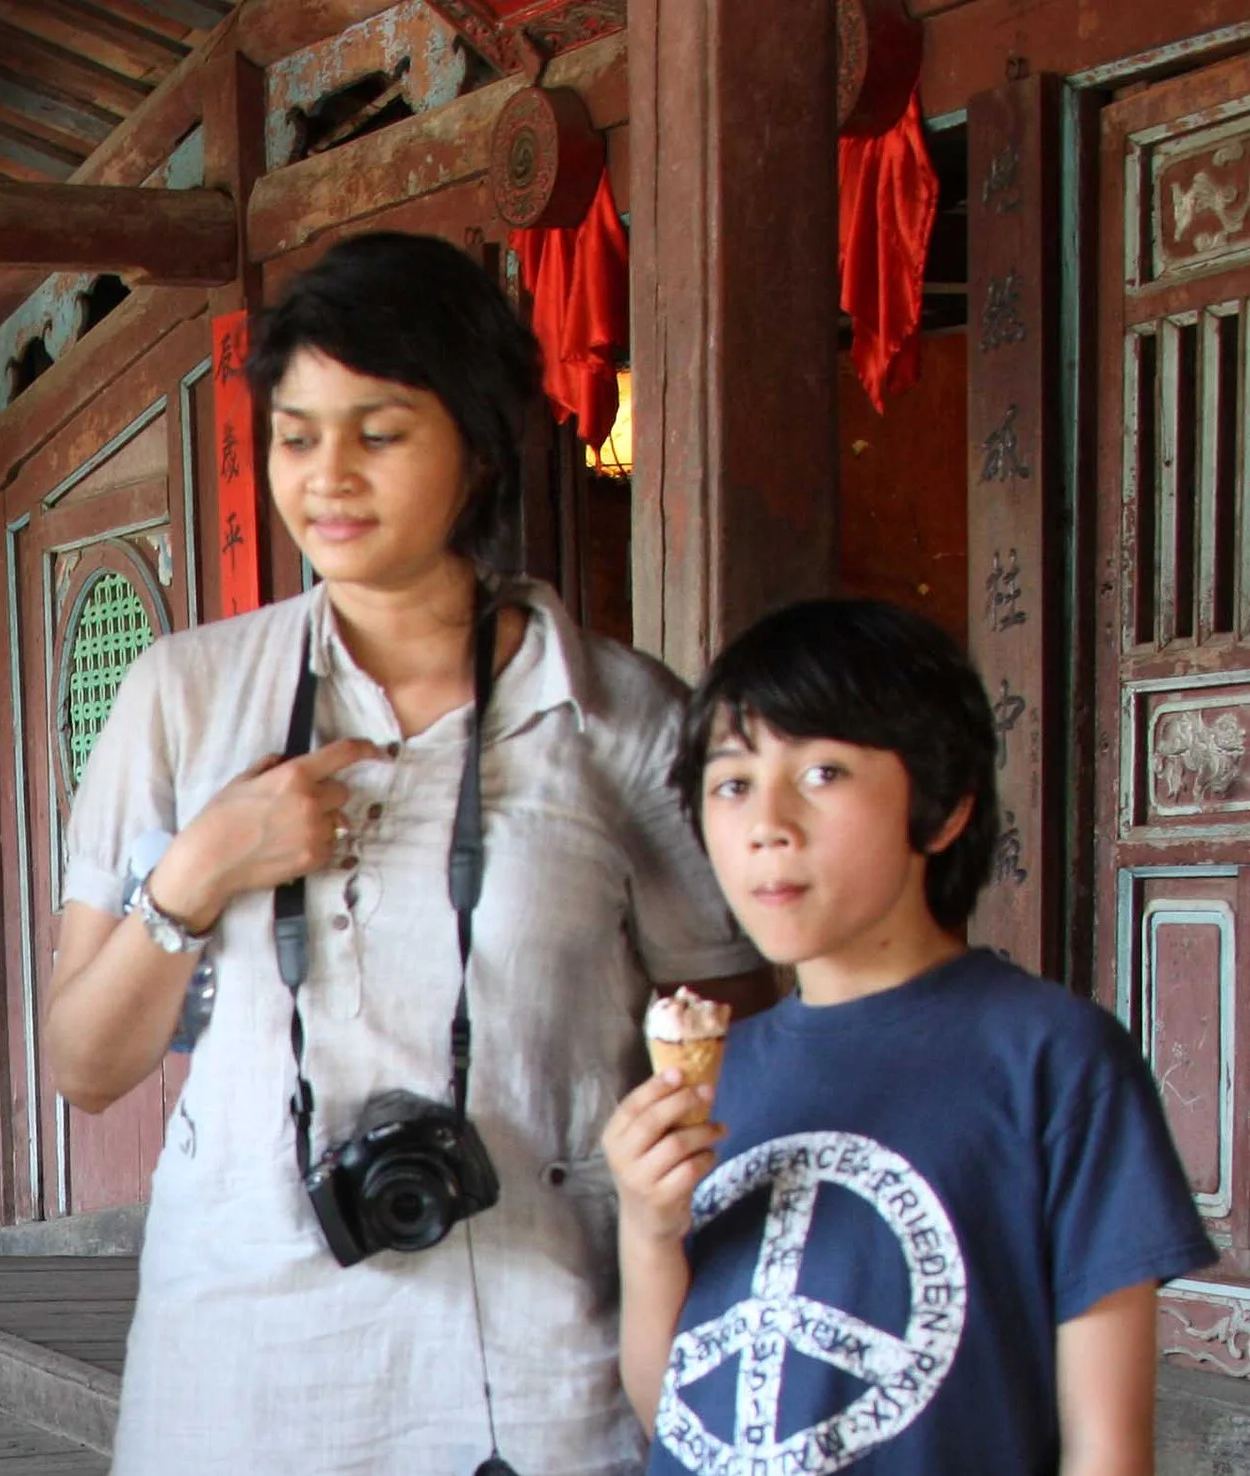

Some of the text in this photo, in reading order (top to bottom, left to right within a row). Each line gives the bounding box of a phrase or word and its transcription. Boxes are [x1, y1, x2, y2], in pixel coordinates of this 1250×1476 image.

[743, 1145, 856, 1180] PEACE
[870, 1170, 951, 1331] FRIEDEN
[860, 1349, 936, 1429] PAIX
